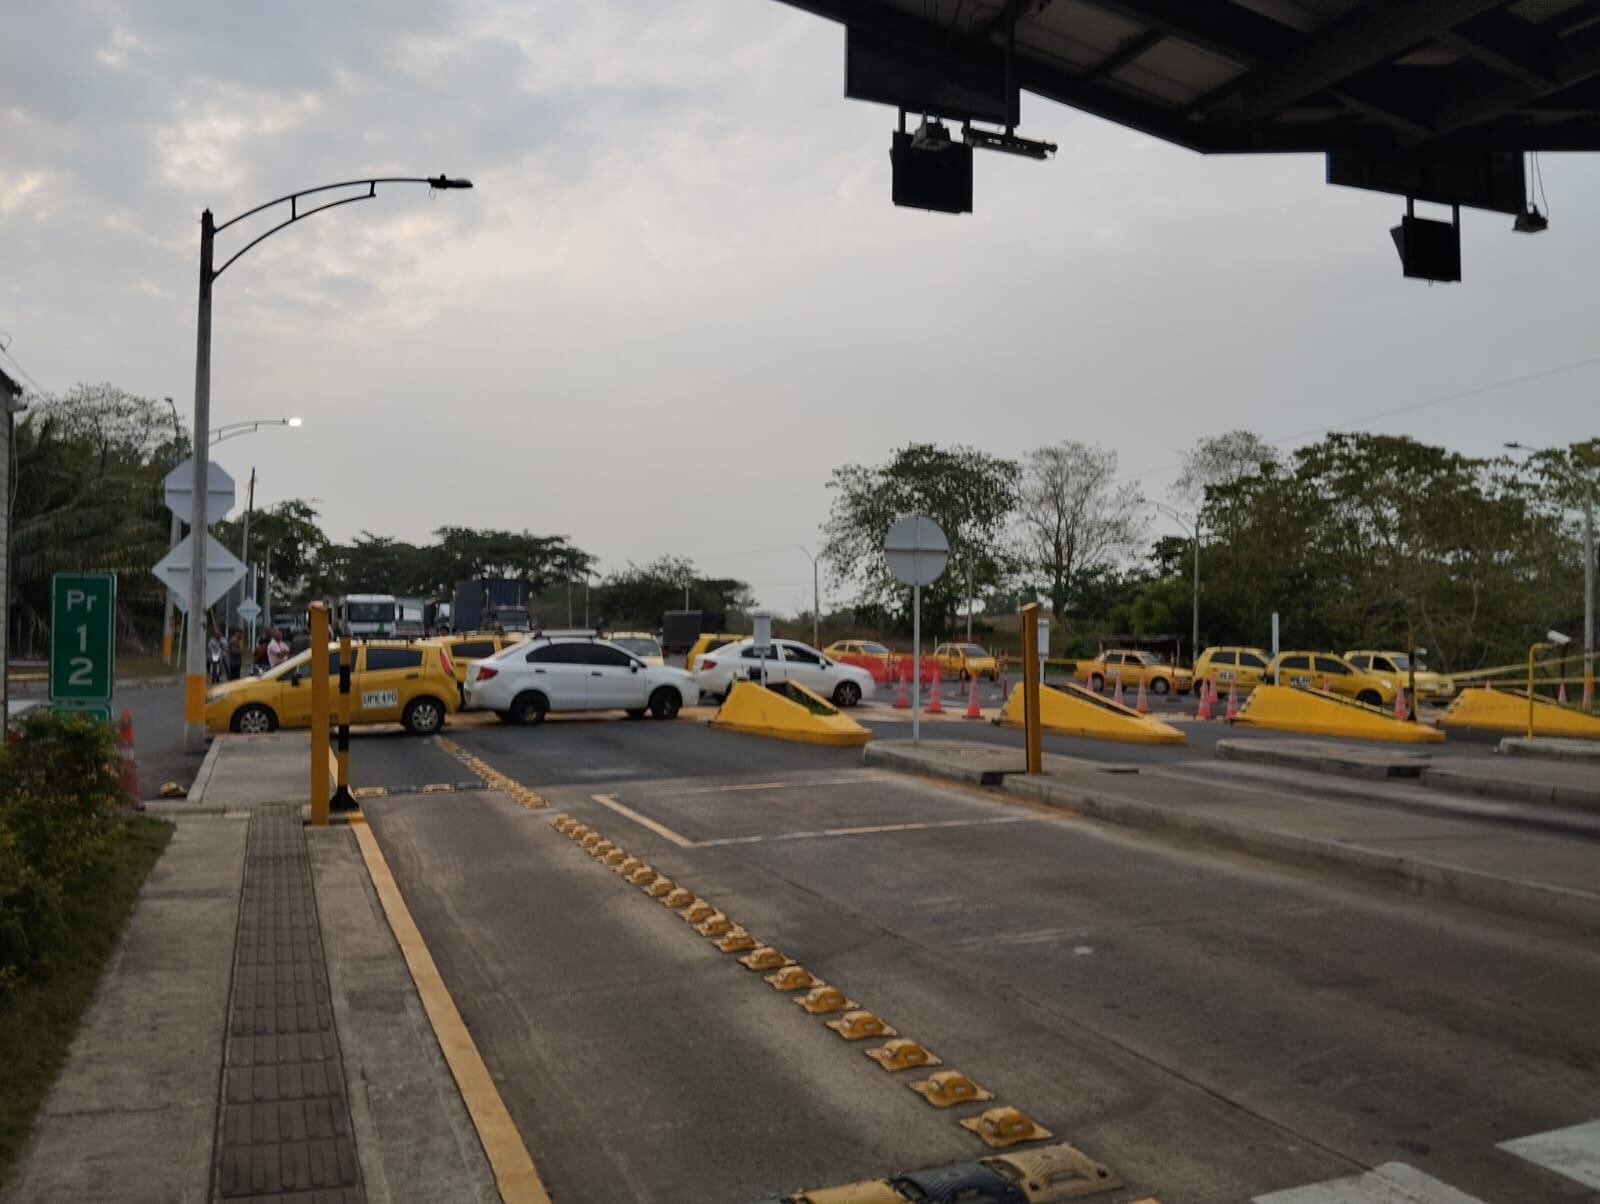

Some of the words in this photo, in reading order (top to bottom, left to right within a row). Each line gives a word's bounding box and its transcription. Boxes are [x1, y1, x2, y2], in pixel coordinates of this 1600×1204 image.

[66, 590, 97, 612] Pr
[76, 624, 88, 653] 1
[68, 657, 93, 686] 2
